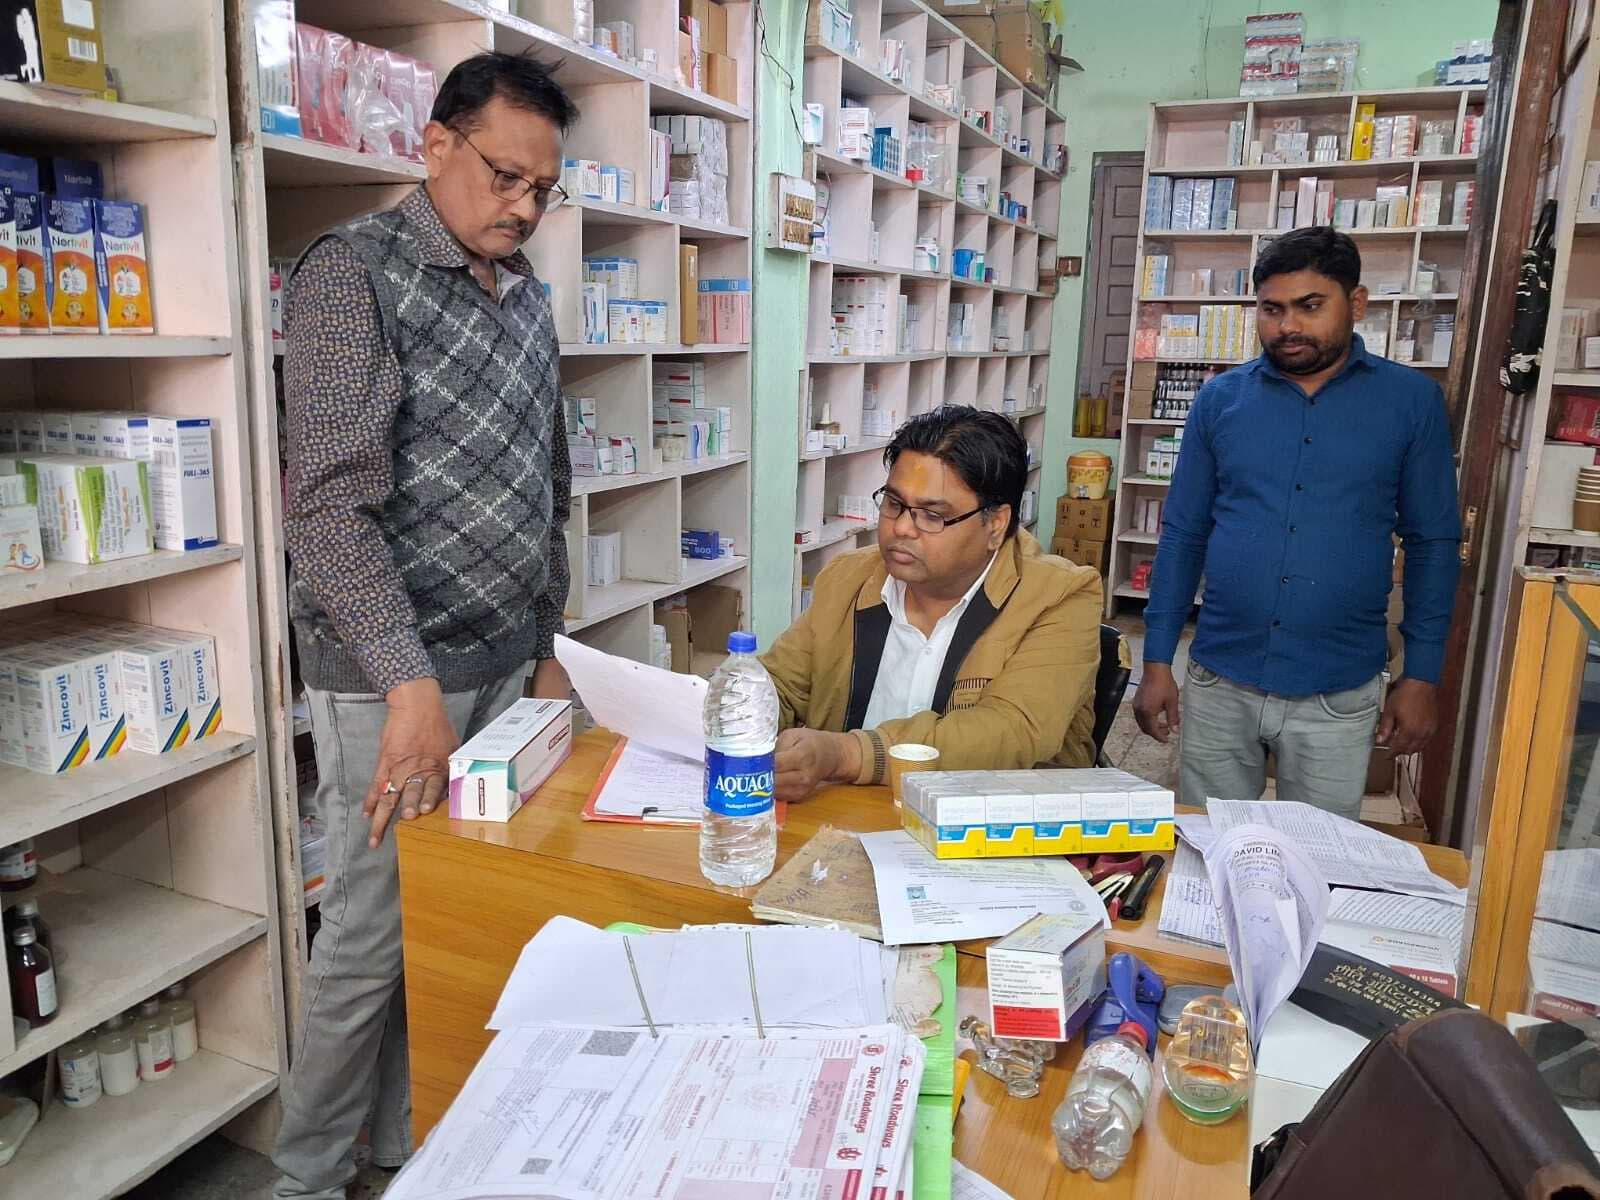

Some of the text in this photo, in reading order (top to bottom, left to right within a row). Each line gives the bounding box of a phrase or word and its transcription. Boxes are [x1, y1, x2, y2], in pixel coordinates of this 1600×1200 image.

[56, 673, 72, 733] Zincovit
[95, 663, 109, 721] Zincovit
[159, 658, 174, 715] Zincovit
[193, 649, 207, 703] Zincovit
[1234, 846, 1263, 858] DAVID
[854, 1065, 882, 1134] Shree Roadways
[894, 1078, 909, 1102] Shree
